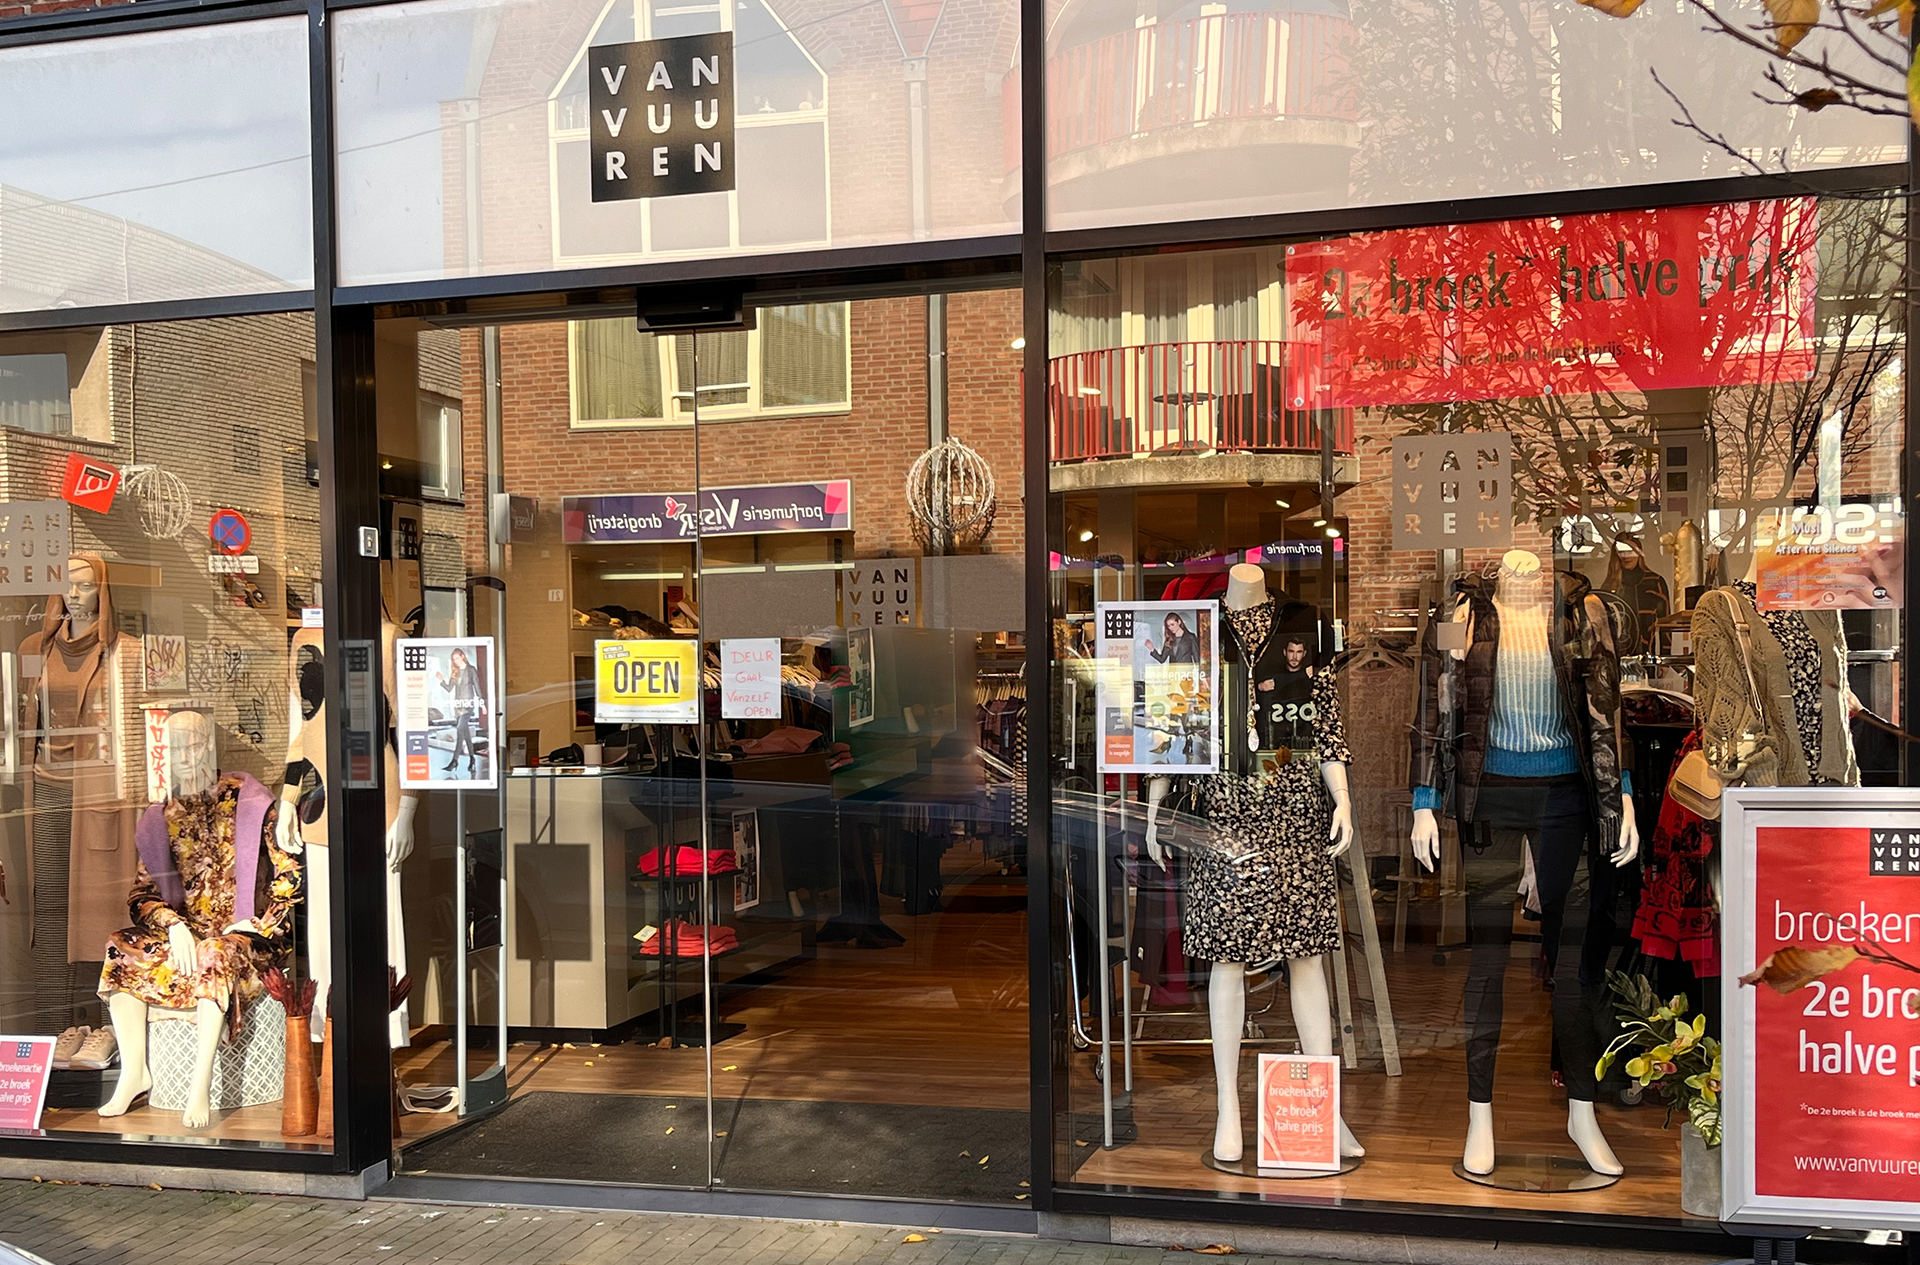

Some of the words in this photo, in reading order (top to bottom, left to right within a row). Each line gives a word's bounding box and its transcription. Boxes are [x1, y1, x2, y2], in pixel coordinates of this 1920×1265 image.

[600, 55, 720, 95] VAN
[601, 99, 719, 138] VUU
[606, 142, 722, 181] REN
[1559, 241, 1679, 304] halve
[1698, 237, 1794, 308] prijs
[1524, 345, 1539, 362] de
[1403, 448, 1500, 471] VAN
[1402, 480, 1499, 504] VUU
[1404, 511, 1500, 535] REN
[1775, 545, 1802, 555] After
[1804, 544, 1821, 554] the
[1823, 544, 1858, 554] Silence
[0, 565, 62, 583] REN
[848, 568, 909, 585] VAN
[1444, 558, 1476, 587] for
[1481, 559, 1544, 581] ladies
[848, 590, 909, 606] VUU
[25, 603, 46, 626] for
[851, 610, 910, 626] REN
[730, 650, 774, 664] DEUR
[614, 660, 679, 694] OPEN
[744, 706, 772, 717] OPEN
[1873, 833, 1920, 845] VAN
[1873, 847, 1920, 858] VUU
[1874, 861, 1920, 872] REN
[1803, 980, 1850, 1018] 2e
[1800, 1029, 1897, 1076] halve
[1269, 1084, 1329, 1098] broekenactie
[1276, 1105, 1288, 1116] 2e
[1820, 1107, 1831, 1116] 2e
[1832, 1107, 1857, 1117] broek
[1858, 1108, 1865, 1117] is
[1867, 1108, 1878, 1118] de
[1879, 1109, 1904, 1119] broek
[1905, 1110, 1920, 1120] me
[1275, 1119, 1299, 1132] halve
[1302, 1122, 1324, 1135] prijs
[1794, 1155, 1920, 1175] www.vanvuure
